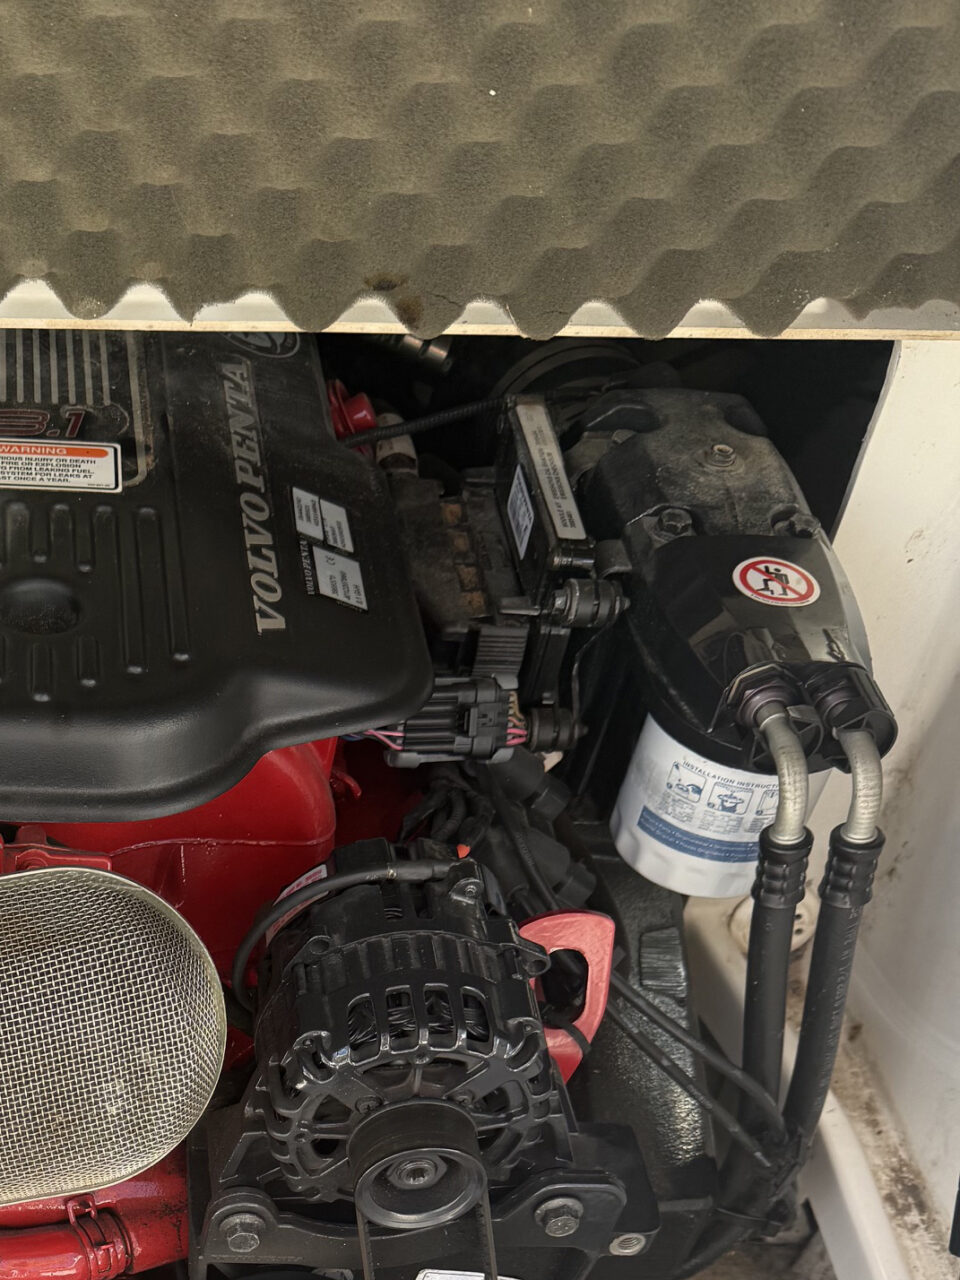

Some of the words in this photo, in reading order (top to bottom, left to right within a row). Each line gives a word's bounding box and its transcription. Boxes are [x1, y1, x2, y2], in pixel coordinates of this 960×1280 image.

[220, 357, 266, 493] PENTA
[239, 491, 287, 634] VOLVO
[681, 760, 736, 785] INSTALLATION
